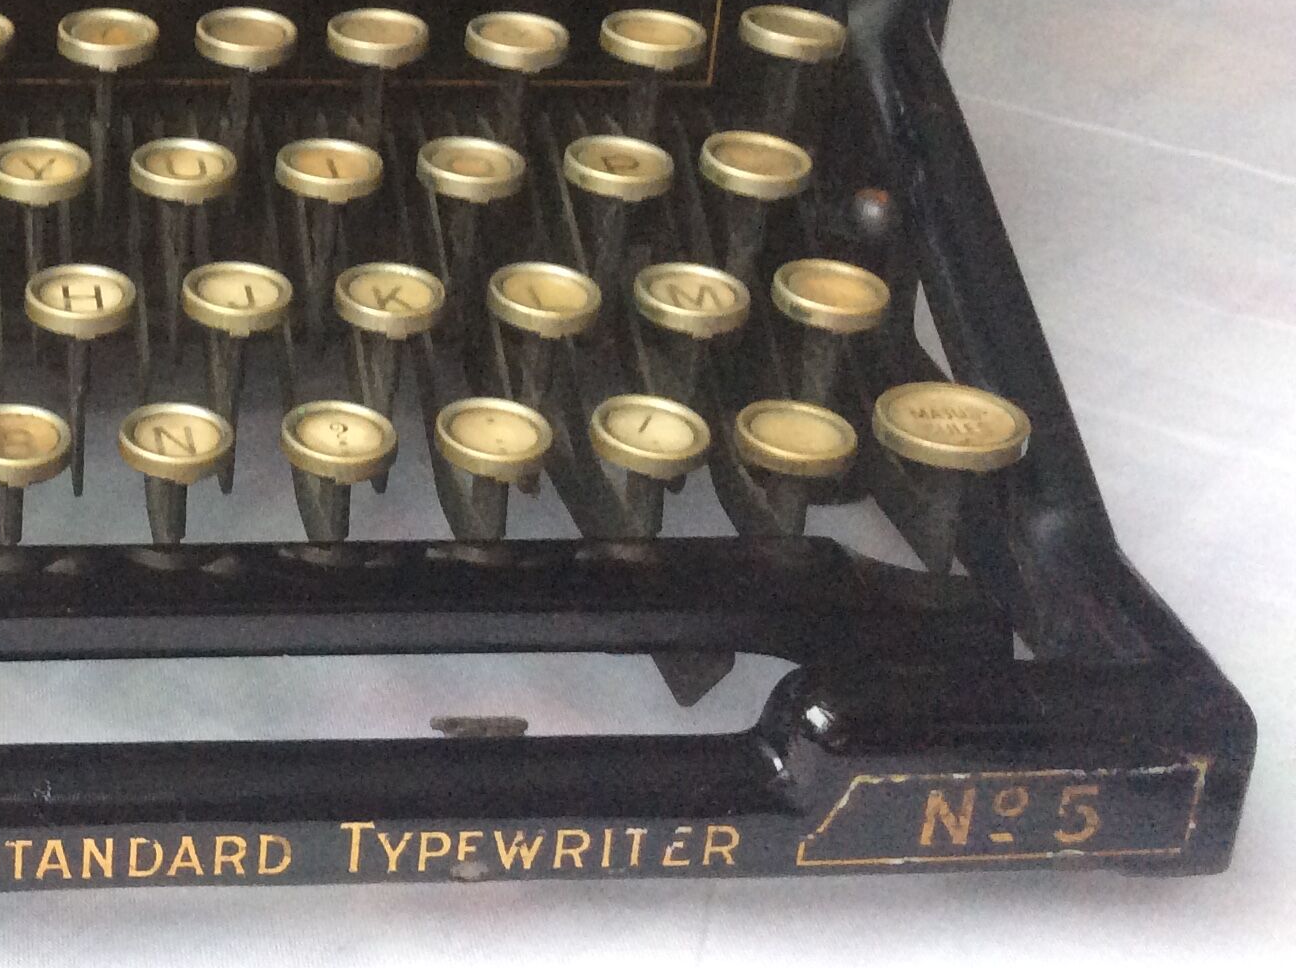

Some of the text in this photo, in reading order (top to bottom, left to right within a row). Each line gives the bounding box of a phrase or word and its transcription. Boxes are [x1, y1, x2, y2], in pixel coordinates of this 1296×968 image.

[20, 157, 56, 181] Y
[62, 284, 105, 313] H
[372, 285, 412, 311] K
[666, 283, 722, 310] M
[152, 425, 198, 455] N
[1054, 785, 1102, 844] 5
[340, 821, 741, 874] TYPEWRITER
